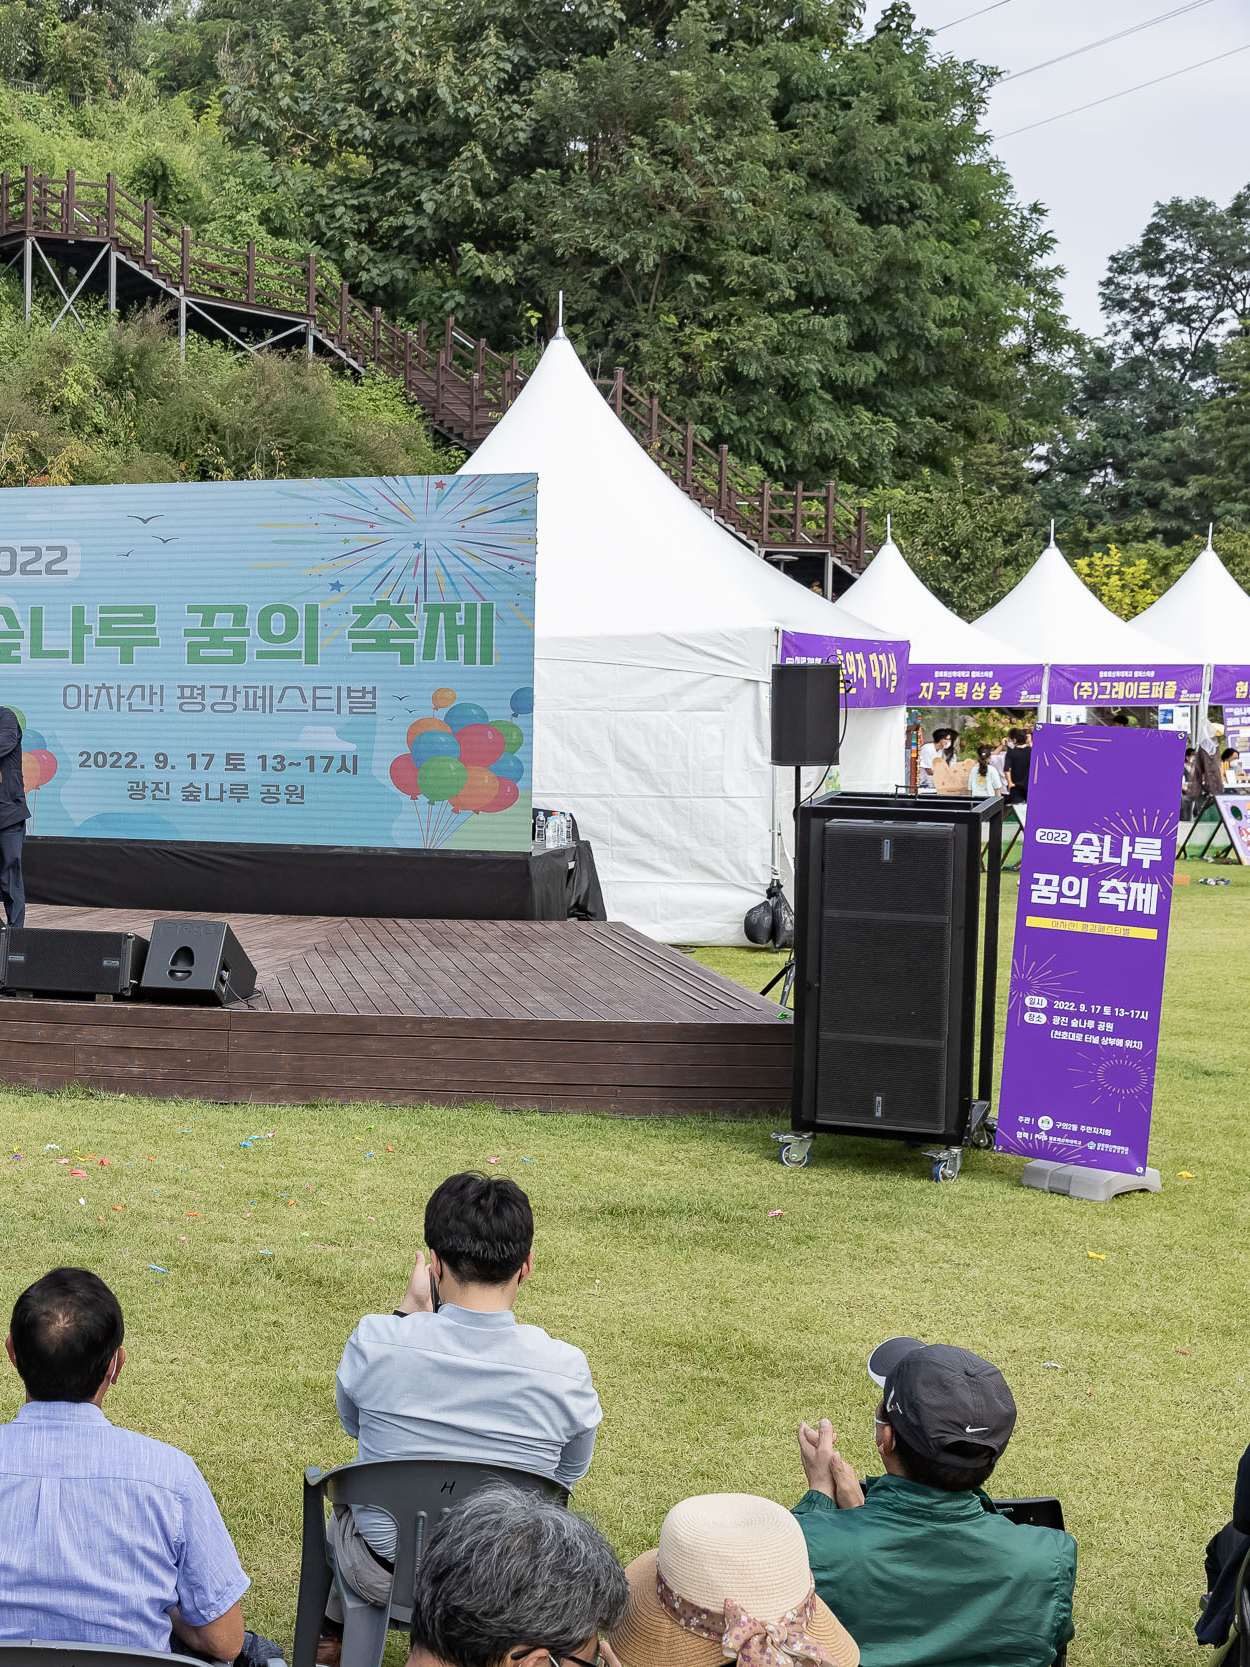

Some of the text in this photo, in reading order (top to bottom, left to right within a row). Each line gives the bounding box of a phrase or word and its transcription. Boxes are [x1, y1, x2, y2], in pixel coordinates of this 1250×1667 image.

[183, 602, 320, 666] 꿈의
[347, 599, 495, 666] 축제
[62, 682, 378, 715] 아차산! 평강페스티벌
[1073, 681, 1177, 700] (주)그레이트퍼즐
[78, 751, 358, 775] 2022. 9. 17 토 13~17시
[126, 780, 306, 805] 광진 숲나루 공원
[1039, 830, 1162, 869] 2022 숲나루
[1030, 872, 1159, 915] 꿈의 축제
[1053, 1000, 1149, 1021] 2022. 9. 17 토 13~17시
[1052, 1015, 1114, 1032] 광진 숲나루 공원
[440, 1480, 456, 1496] H
